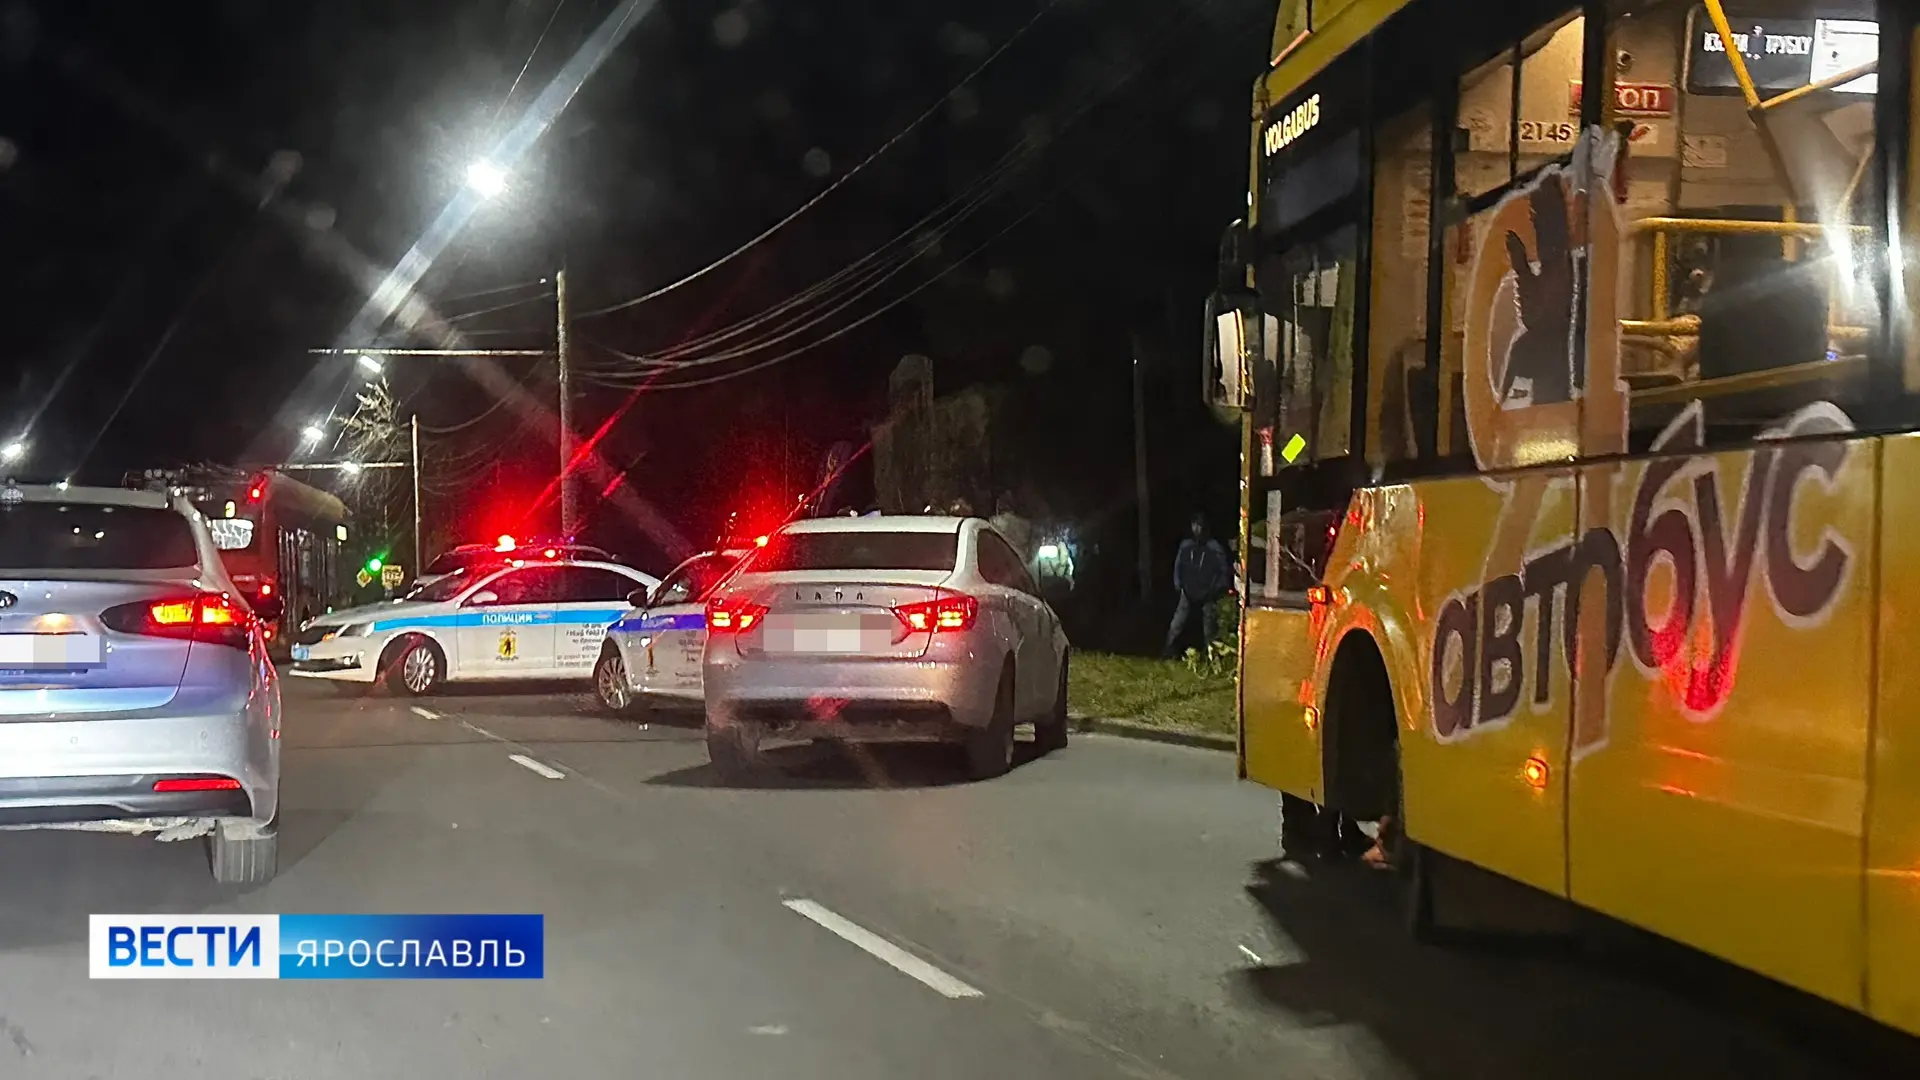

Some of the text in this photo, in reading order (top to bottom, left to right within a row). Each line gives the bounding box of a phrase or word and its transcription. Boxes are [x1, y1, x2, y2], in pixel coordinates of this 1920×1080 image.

[1265, 93, 1320, 157] VOLGABUS
[1520, 122, 1572, 142] 2145
[795, 591, 864, 601] LADA
